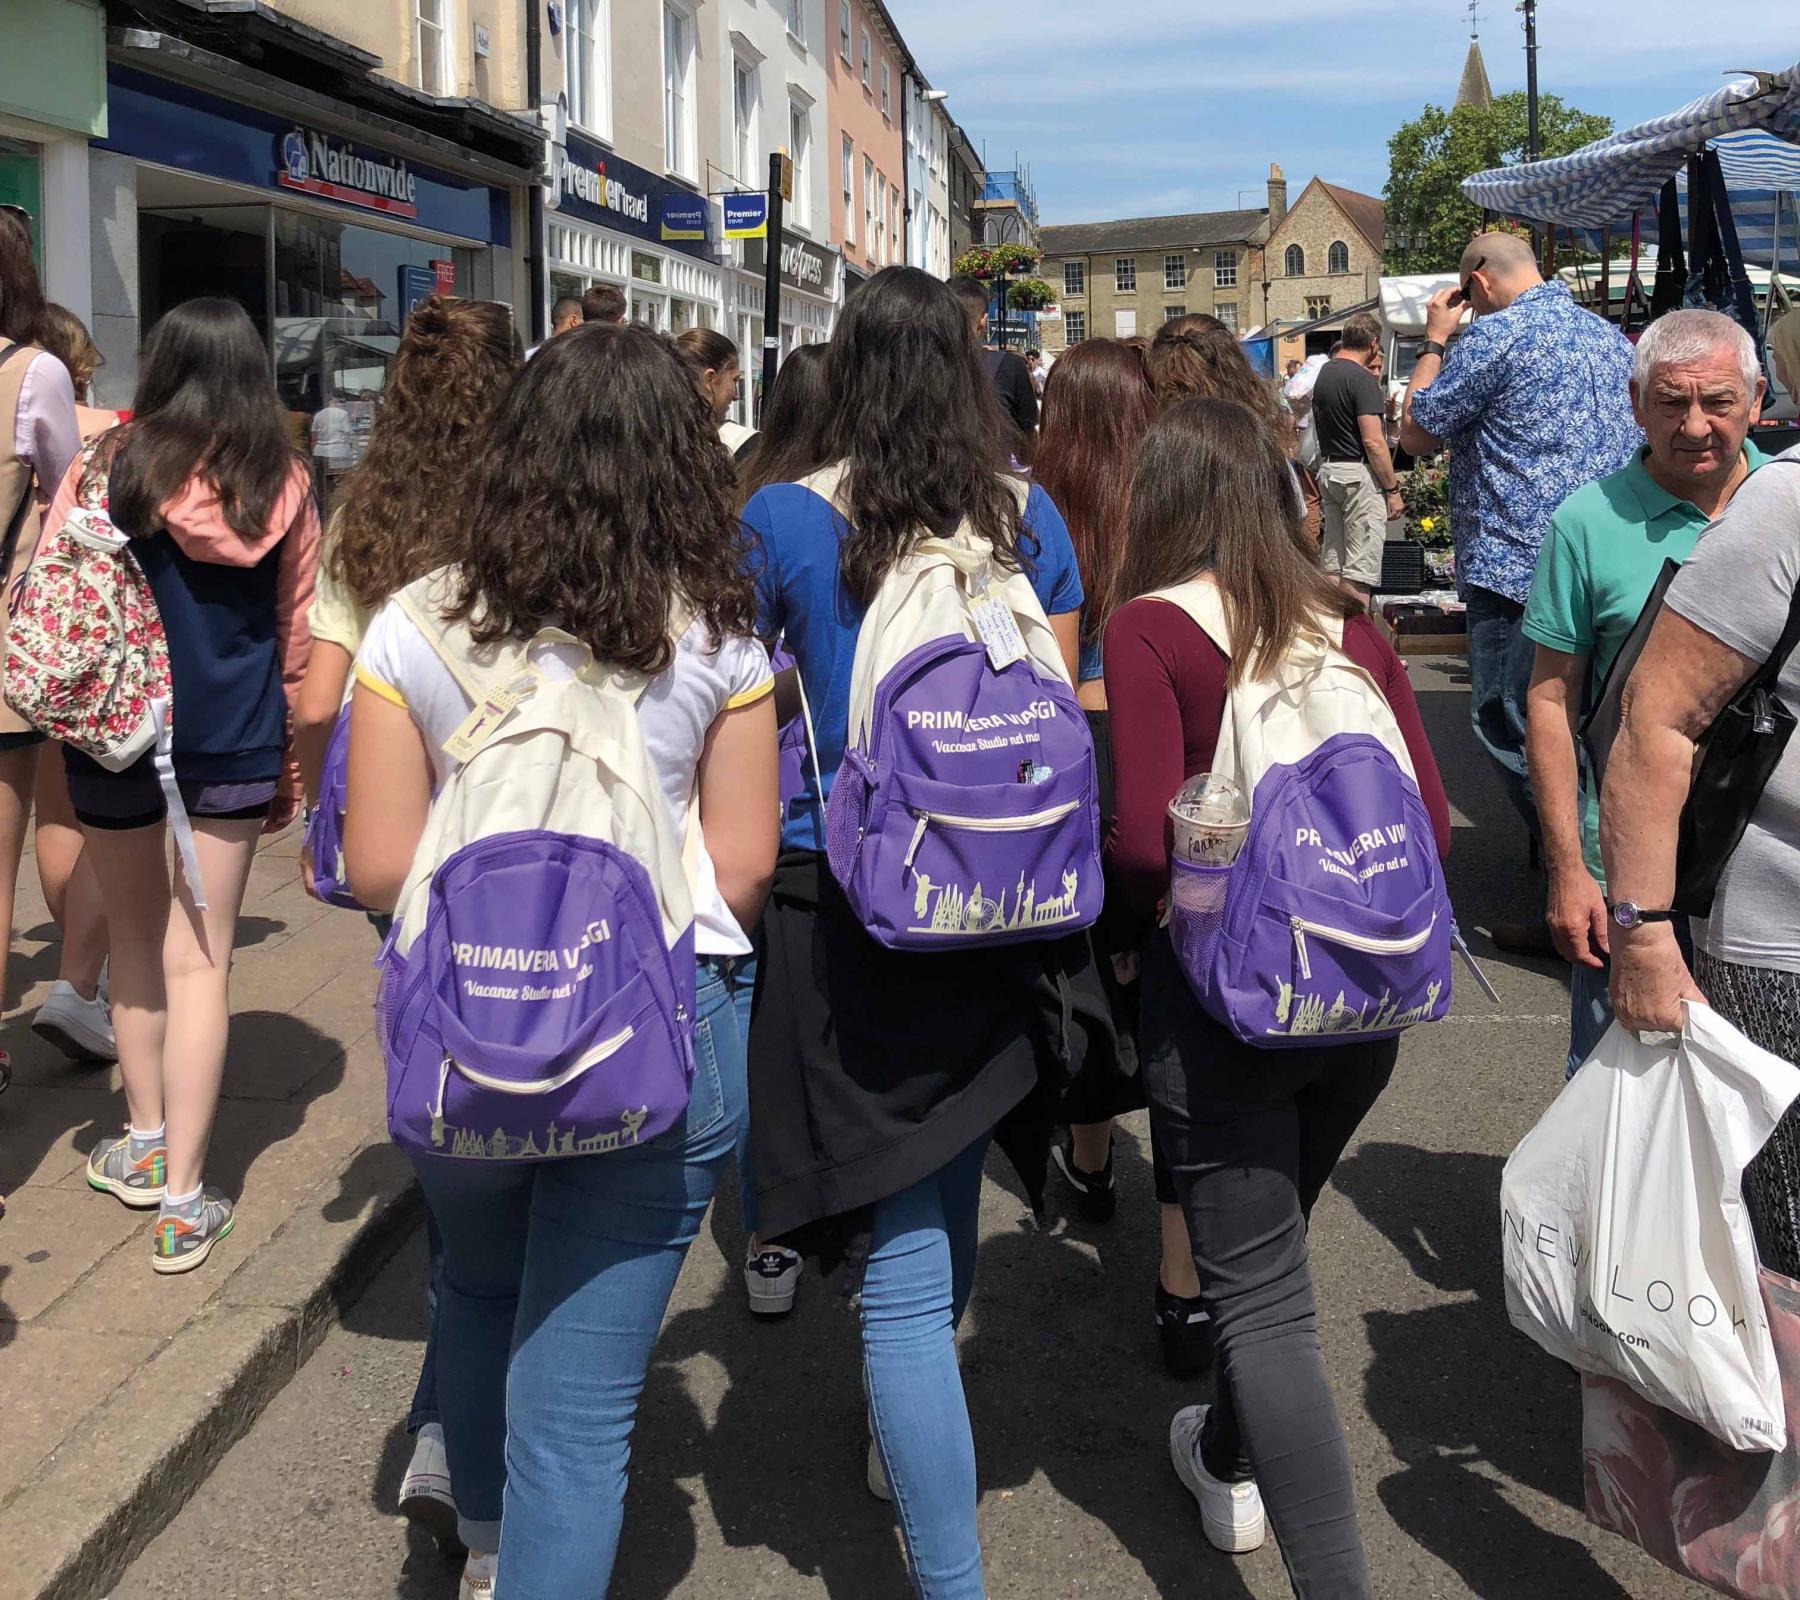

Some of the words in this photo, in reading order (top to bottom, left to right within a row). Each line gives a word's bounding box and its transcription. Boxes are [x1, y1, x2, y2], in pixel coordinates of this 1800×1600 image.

[310, 131, 417, 203] Nationwide
[555, 147, 624, 212] Premier
[622, 187, 648, 223] travel
[727, 209, 763, 219] Premier
[1010, 732, 1025, 746] nel
[464, 979, 519, 1000] Vacanze
